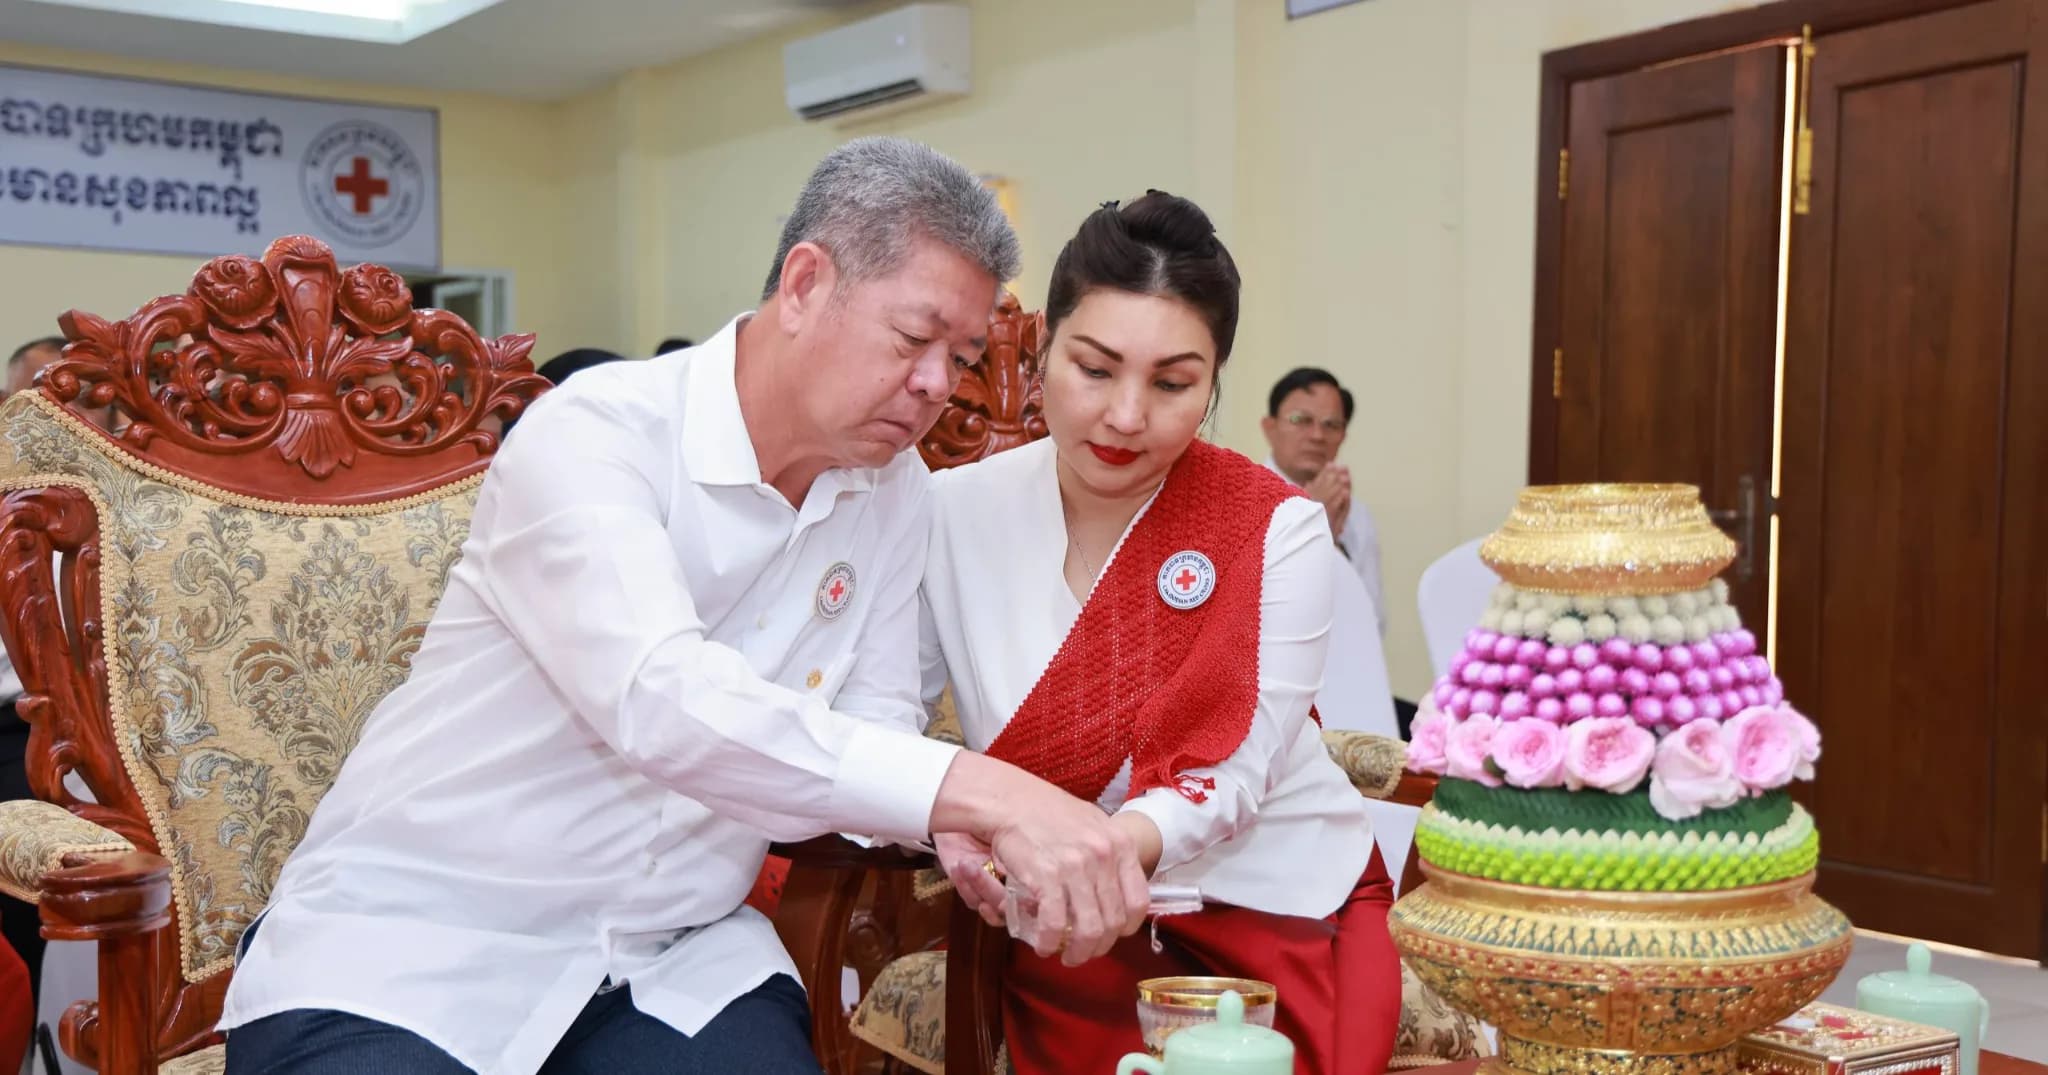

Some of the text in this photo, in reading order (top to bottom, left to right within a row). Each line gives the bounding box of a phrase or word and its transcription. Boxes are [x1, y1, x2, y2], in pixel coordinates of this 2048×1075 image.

[0, 166, 261, 234] មានសុខភាពល្អ
